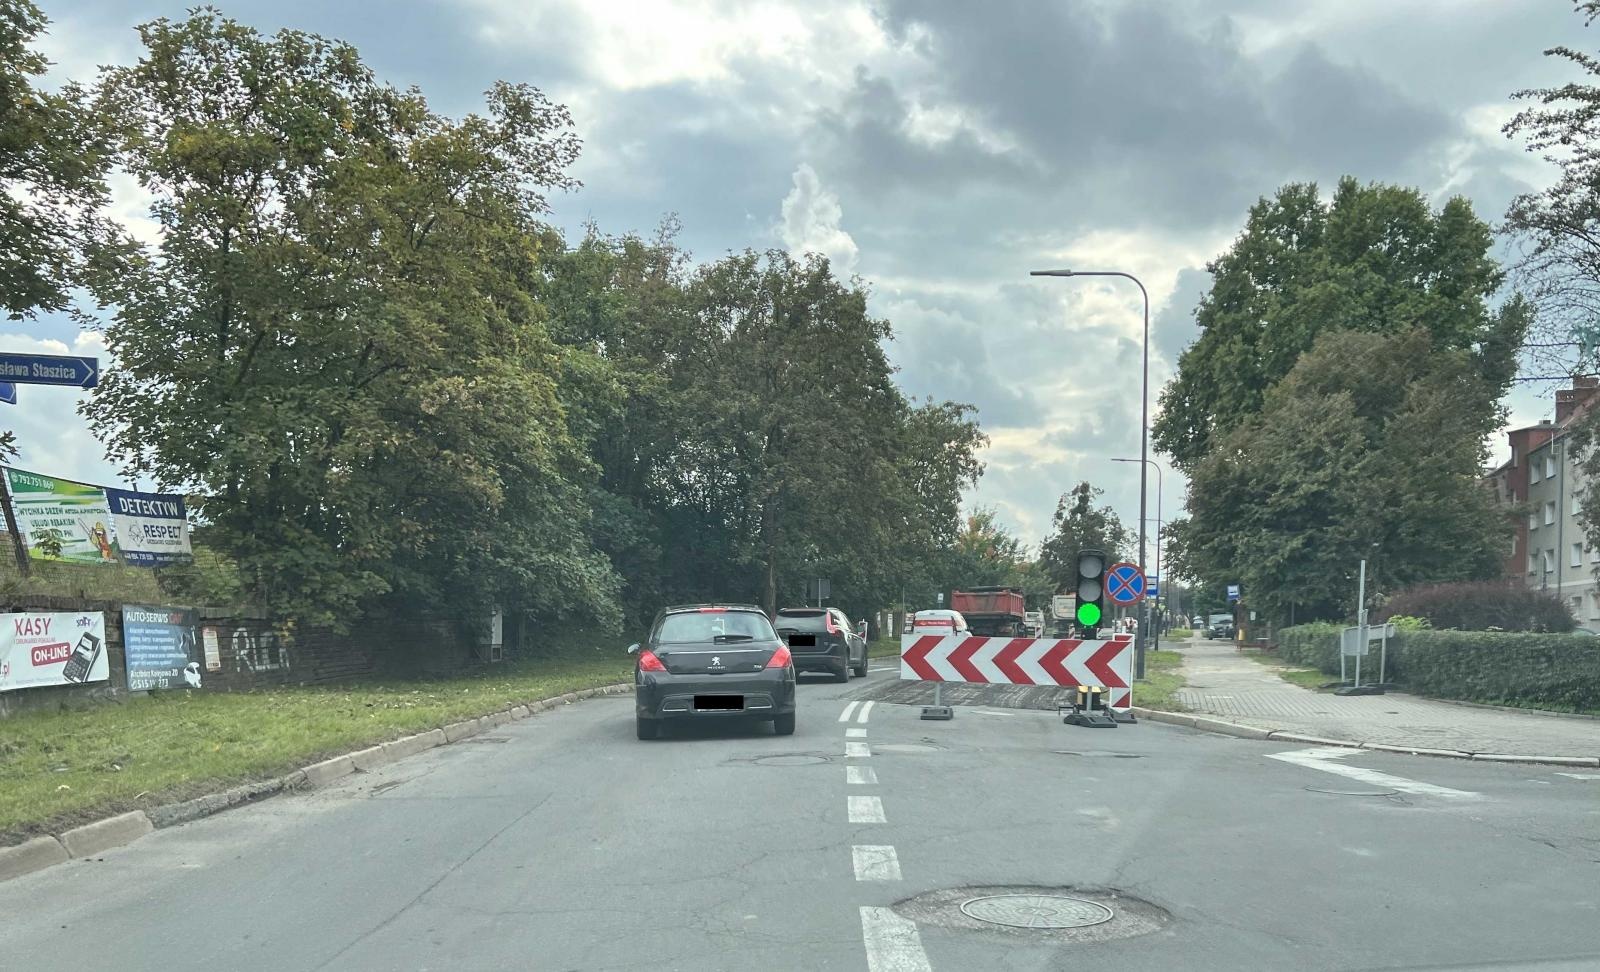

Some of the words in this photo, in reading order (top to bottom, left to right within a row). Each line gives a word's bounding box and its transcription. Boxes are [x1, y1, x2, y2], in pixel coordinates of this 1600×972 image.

[32, 362, 76, 379] Staszica
[17, 506, 45, 517] WYCINKA
[45, 506, 64, 516] DRZEW
[118, 497, 179, 517] DETEKTYW
[142, 524, 182, 540] RESPECT
[126, 611, 169, 624] AUTO-SERWIS
[14, 617, 52, 637] KASY
[34, 645, 69, 663] ON-LINE
[172, 668, 179, 677] 20
